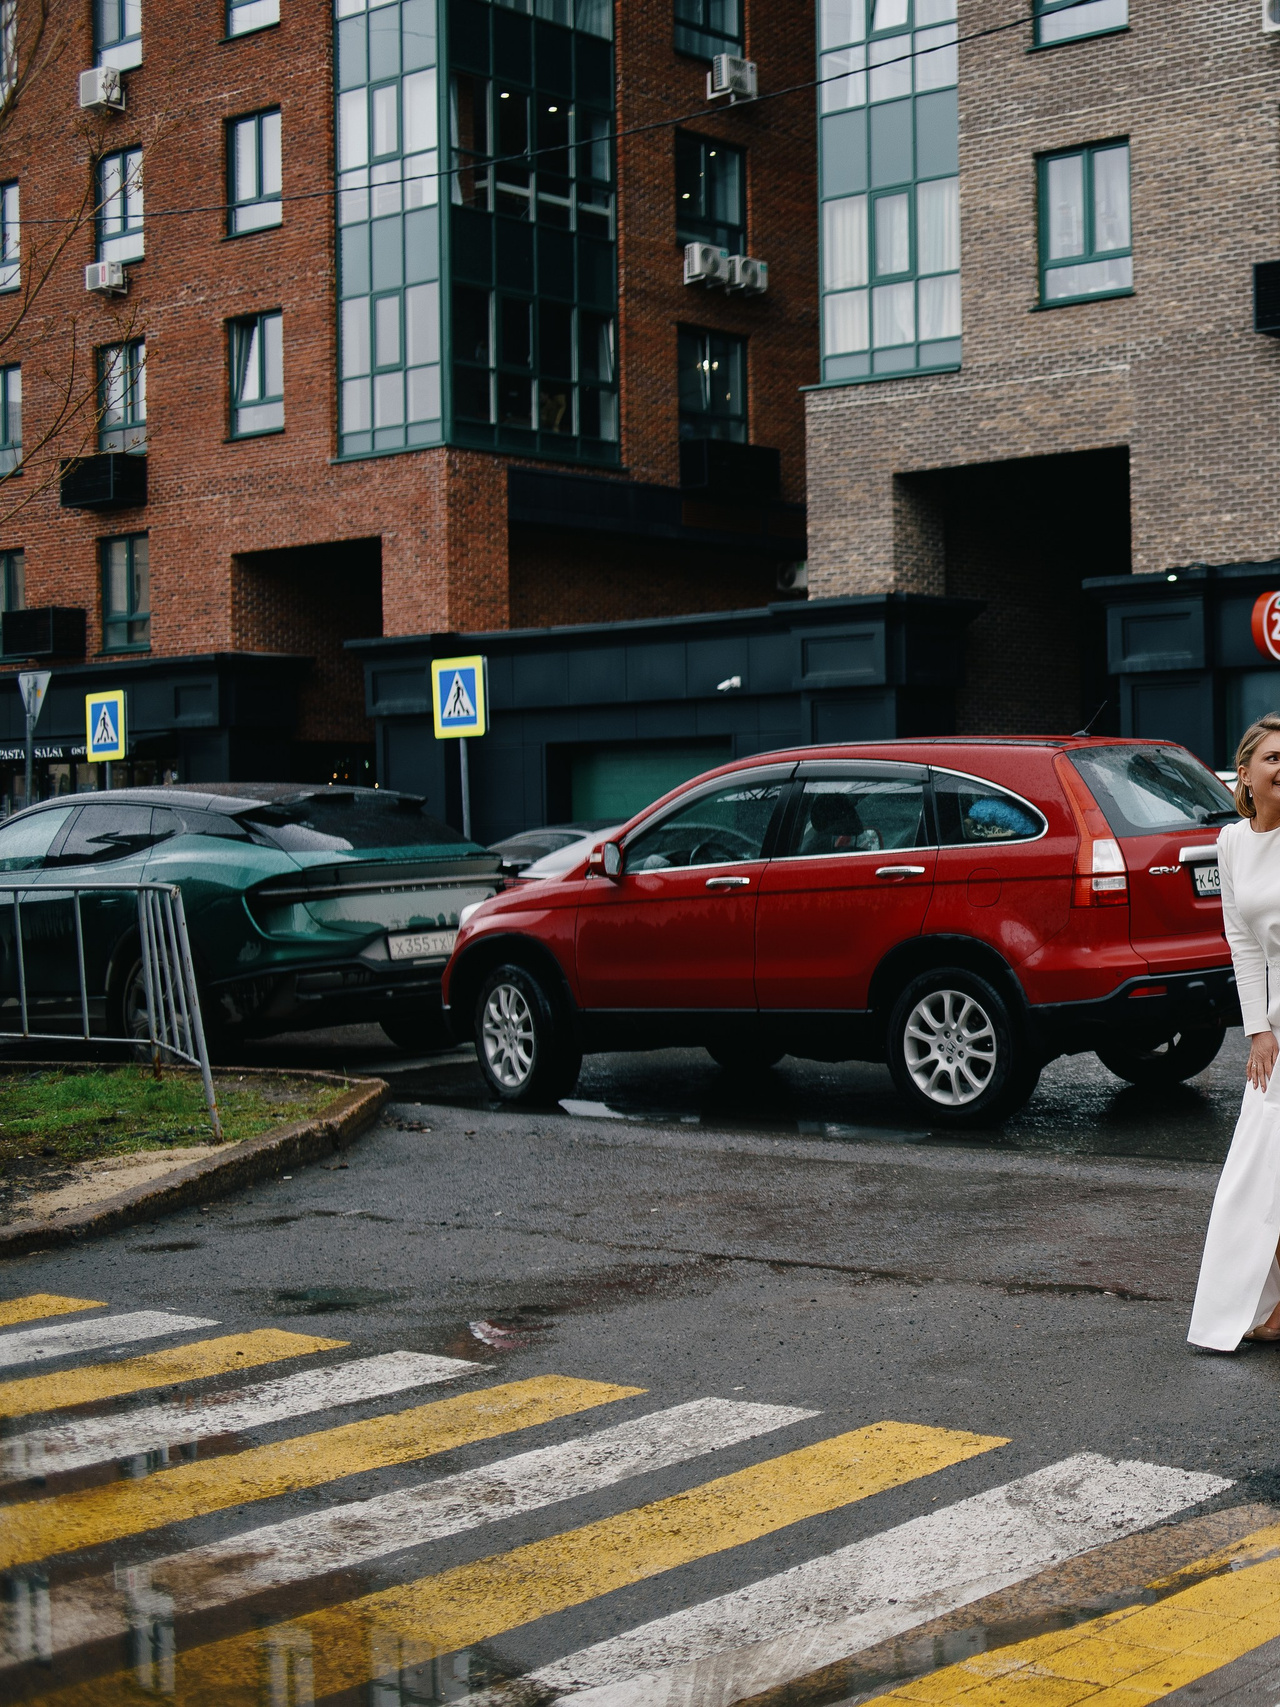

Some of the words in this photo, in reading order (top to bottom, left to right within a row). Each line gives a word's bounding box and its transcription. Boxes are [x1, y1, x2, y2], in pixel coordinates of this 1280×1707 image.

[34, 747, 63, 758] SALSA
[71, 746, 87, 756] OST
[1148, 865, 1181, 875] CR-V
